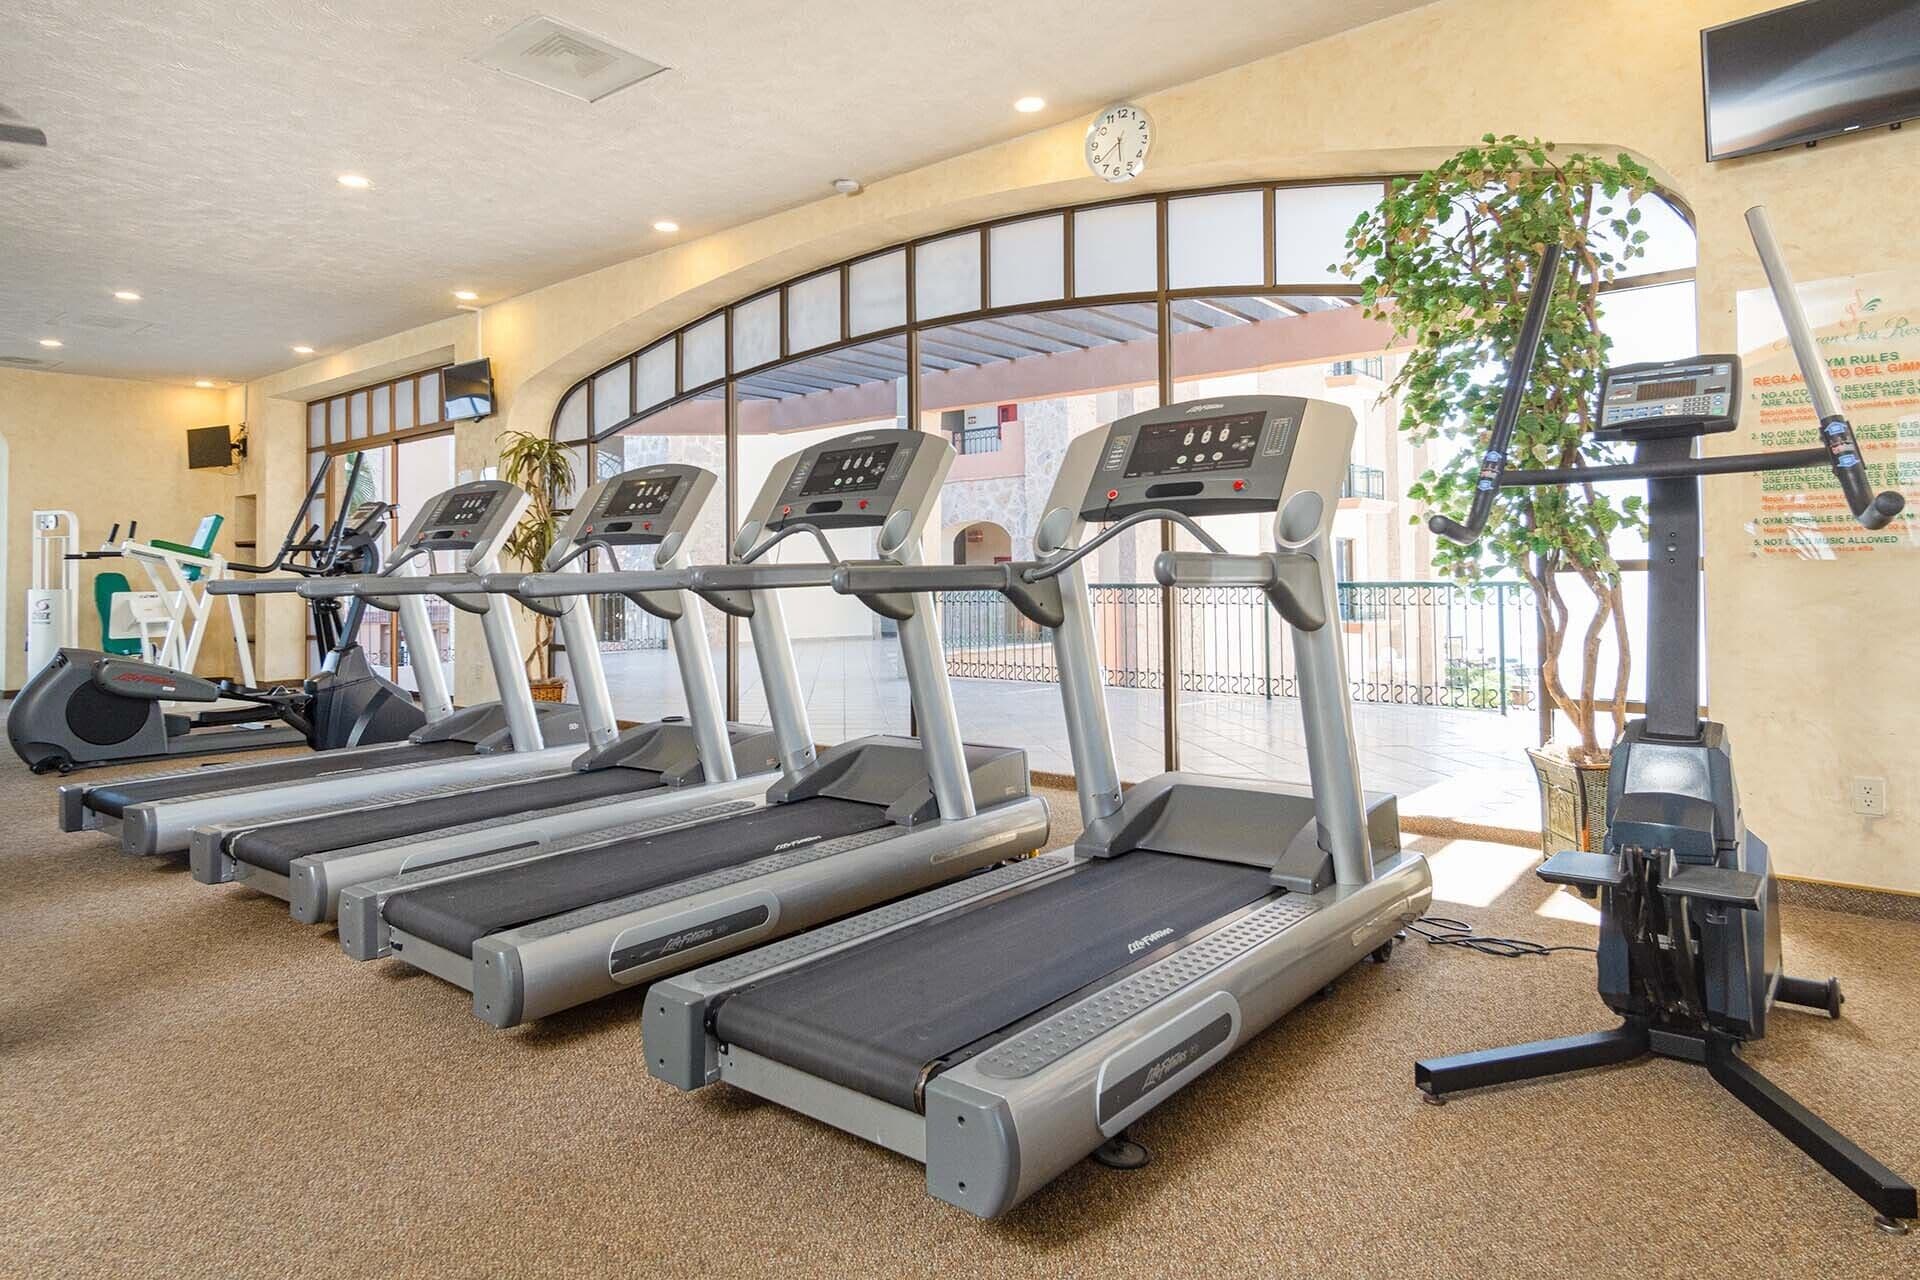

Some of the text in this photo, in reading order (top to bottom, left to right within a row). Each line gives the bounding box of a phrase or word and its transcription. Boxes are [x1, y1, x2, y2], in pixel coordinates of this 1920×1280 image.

[1117, 109, 1128, 118] 12
[1106, 114, 1114, 124] 11
[1138, 120, 1146, 130] 2
[1141, 135, 1148, 144] 3
[1091, 142, 1098, 151] 9
[1093, 155, 1100, 164] 8
[1102, 164, 1109, 174] 7
[1126, 161, 1133, 171] 5
[1113, 167, 1120, 176] 6
[1824, 351, 1899, 367] YM RULES
[1854, 364, 1882, 377] DEL
[1761, 391, 1776, 399] NO
[1844, 379, 1914, 392] BEVERAGES
[1841, 390, 1878, 400] INSIDE
[1881, 387, 1903, 396] THE
[1761, 431, 1774, 439] NO
[1776, 429, 1797, 438] ONE
[1799, 428, 1818, 436] UND
[1856, 424, 1878, 432] AGE
[1880, 423, 1894, 431] OF
[1761, 439, 1774, 447] TO
[1776, 437, 1795, 445] USE
[1855, 430, 1896, 440] FITNESS
[1763, 475, 1781, 484] USE
[1784, 473, 1824, 483] FITNESS
[1762, 517, 1782, 525] GYM
[1764, 538, 1782, 546] NOT
[1847, 535, 1898, 544] ALLOWED
